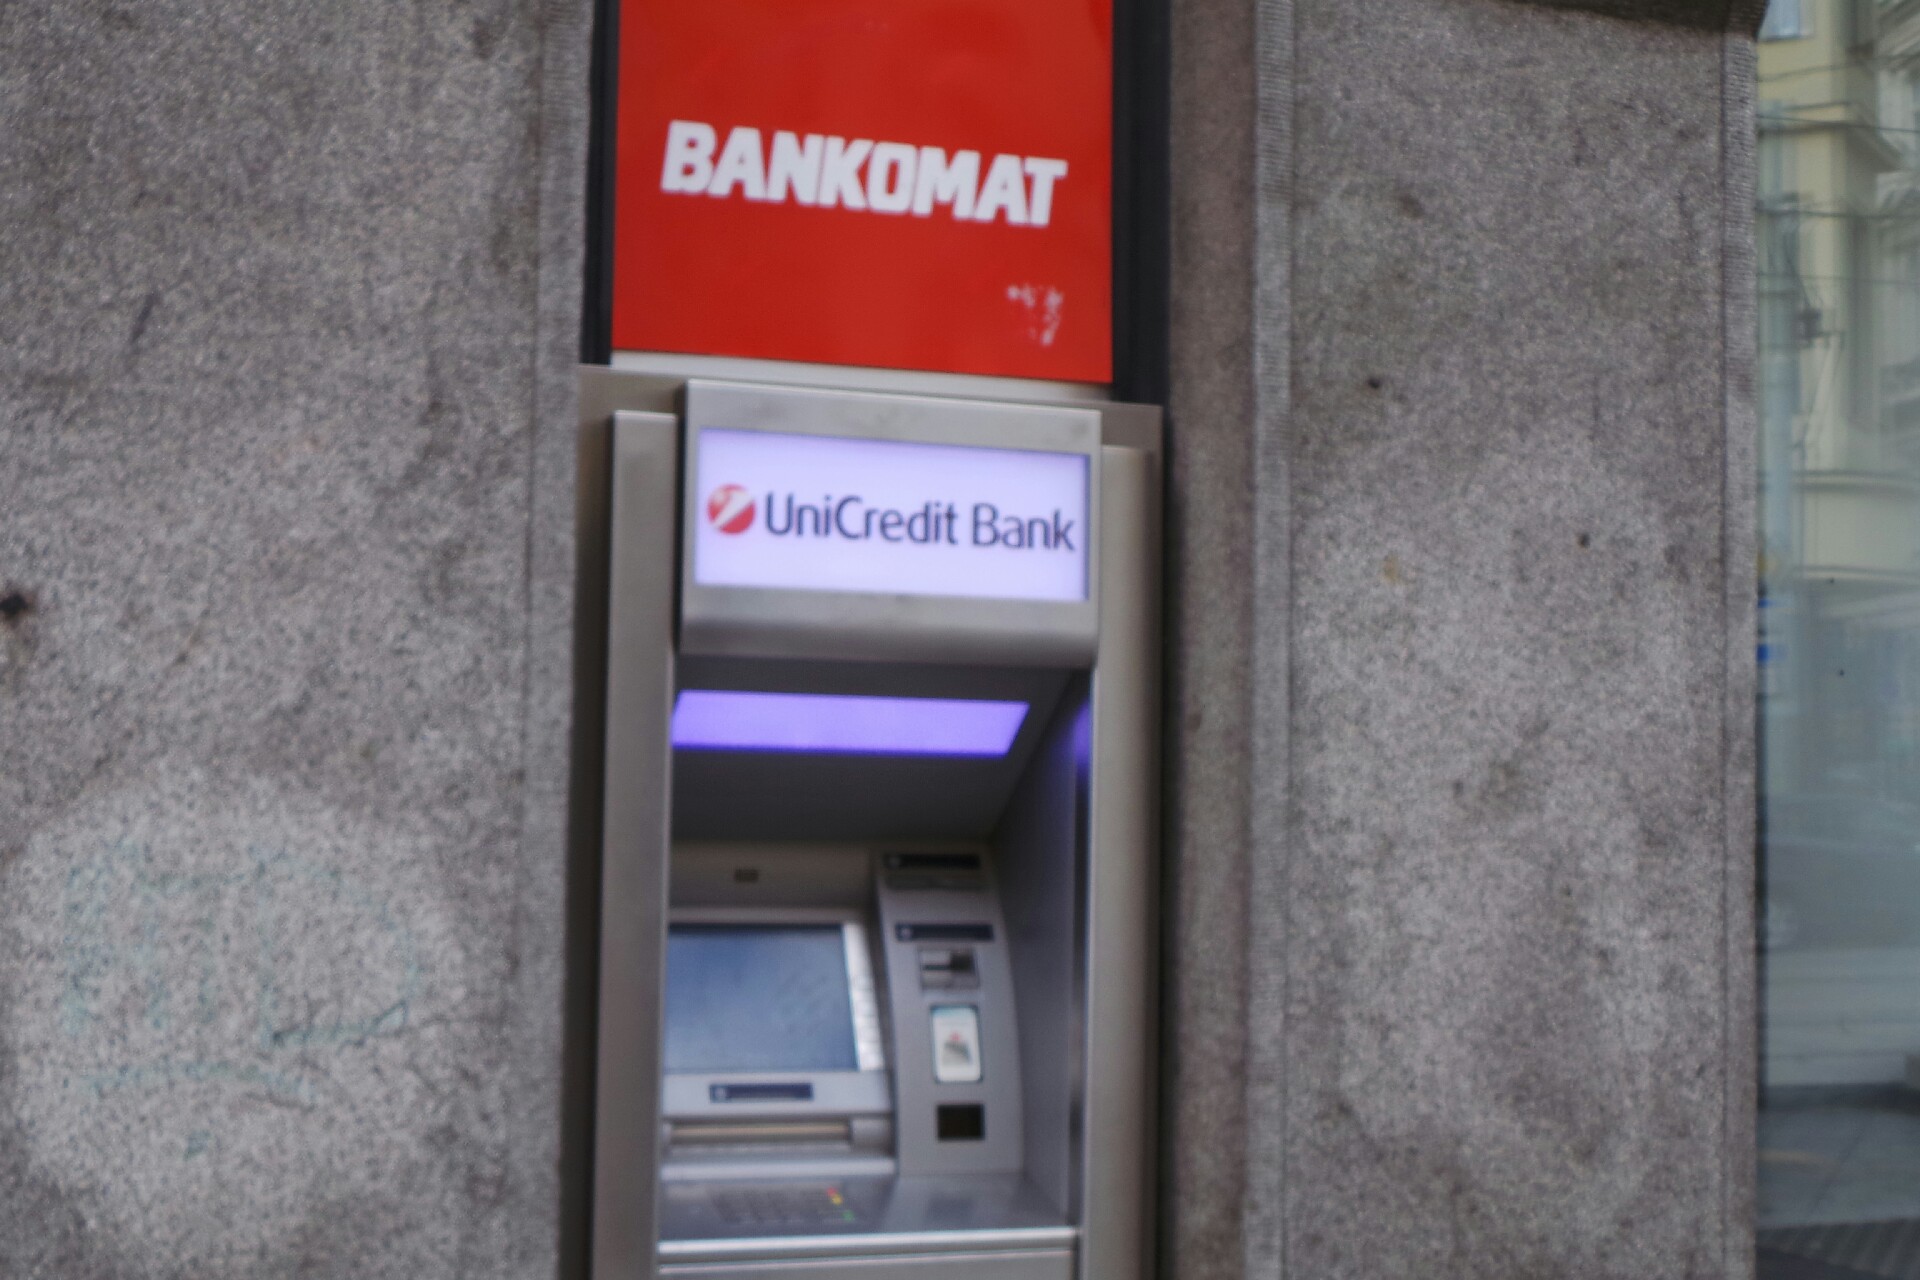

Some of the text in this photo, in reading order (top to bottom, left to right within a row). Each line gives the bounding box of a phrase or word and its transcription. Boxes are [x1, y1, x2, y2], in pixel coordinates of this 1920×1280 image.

[660, 119, 1069, 228] BANKOMAT
[765, 490, 1077, 552] UniCredit Bank
